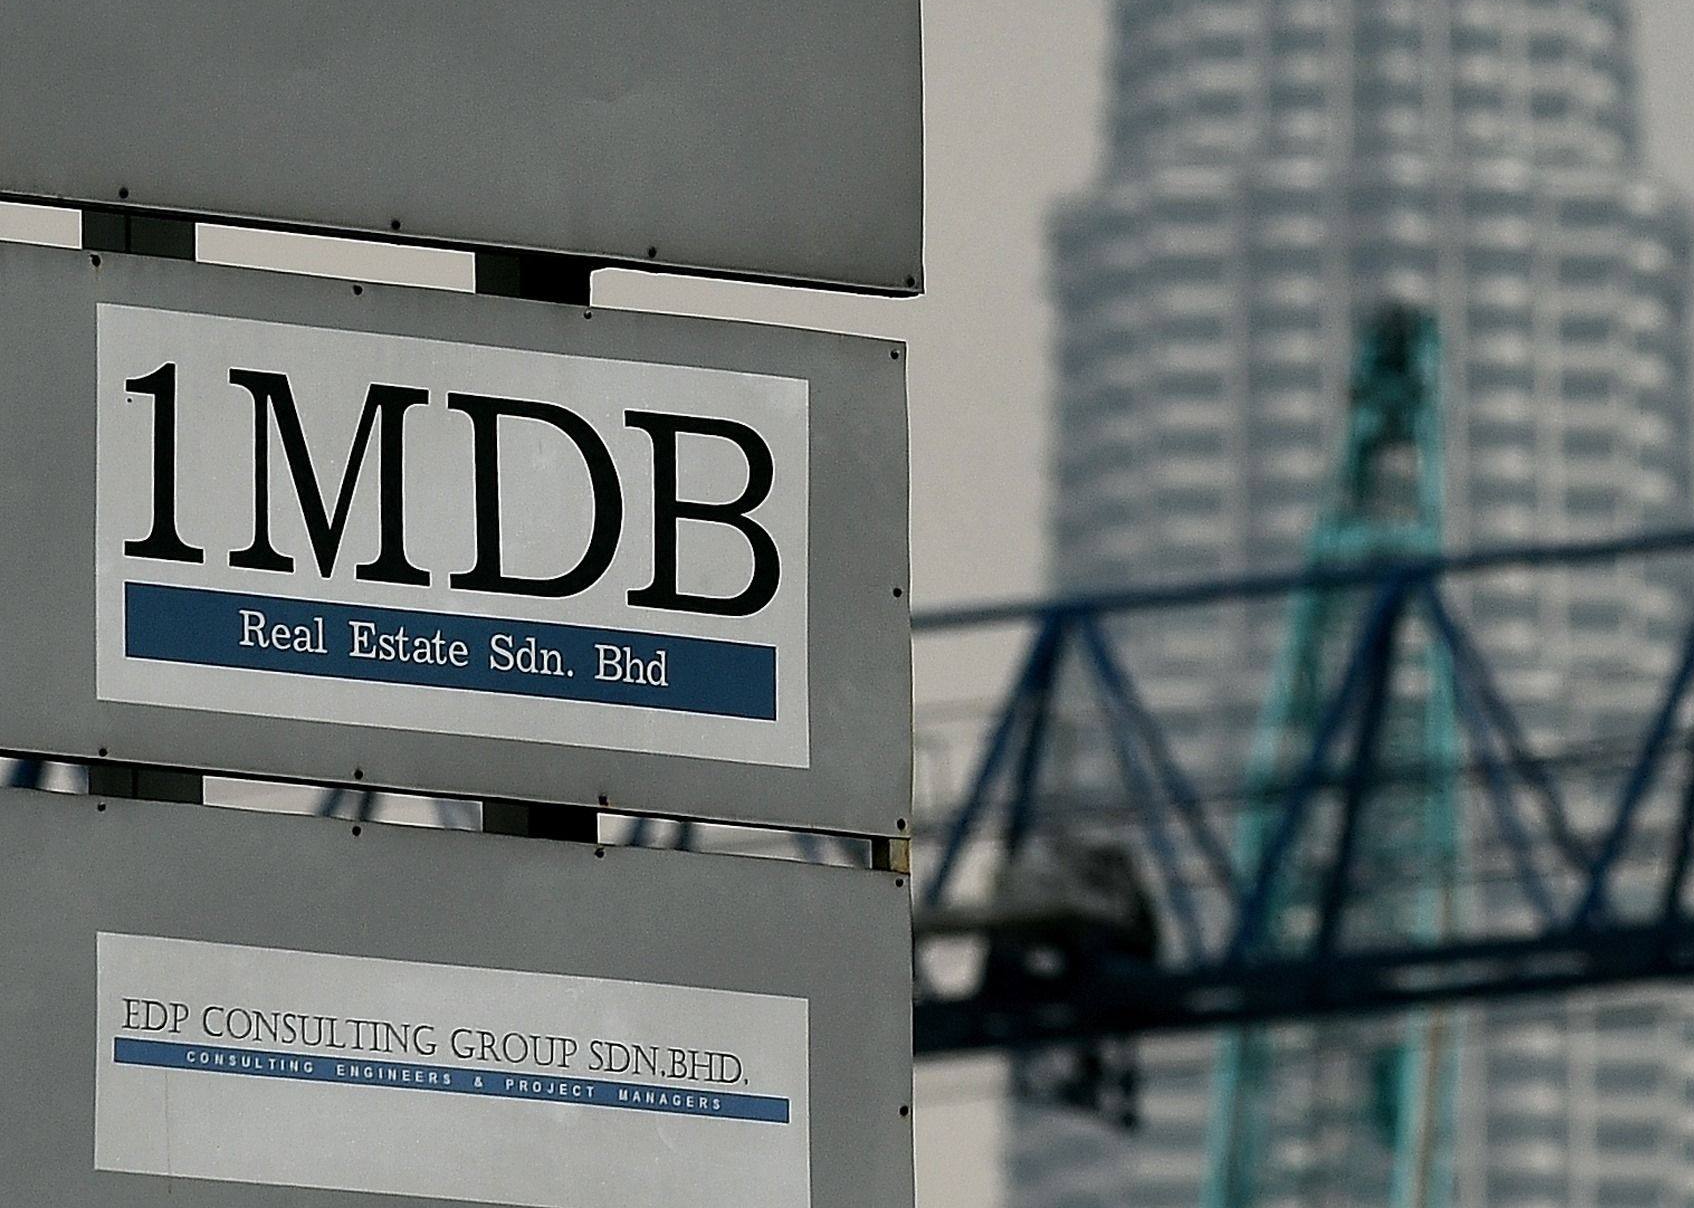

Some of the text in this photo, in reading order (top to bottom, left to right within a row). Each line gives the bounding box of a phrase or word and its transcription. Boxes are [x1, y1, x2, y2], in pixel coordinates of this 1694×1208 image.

[123, 361, 782, 618] 1MDB
[238, 609, 670, 687] Real Estate Sdn. Bhd
[121, 997, 190, 1033] EDP
[202, 1005, 438, 1057] CONSULTING
[450, 1027, 579, 1068] GROUP
[186, 1050, 722, 1111] CONSULTING ENGINEERS & PROJECT MANAGERS
